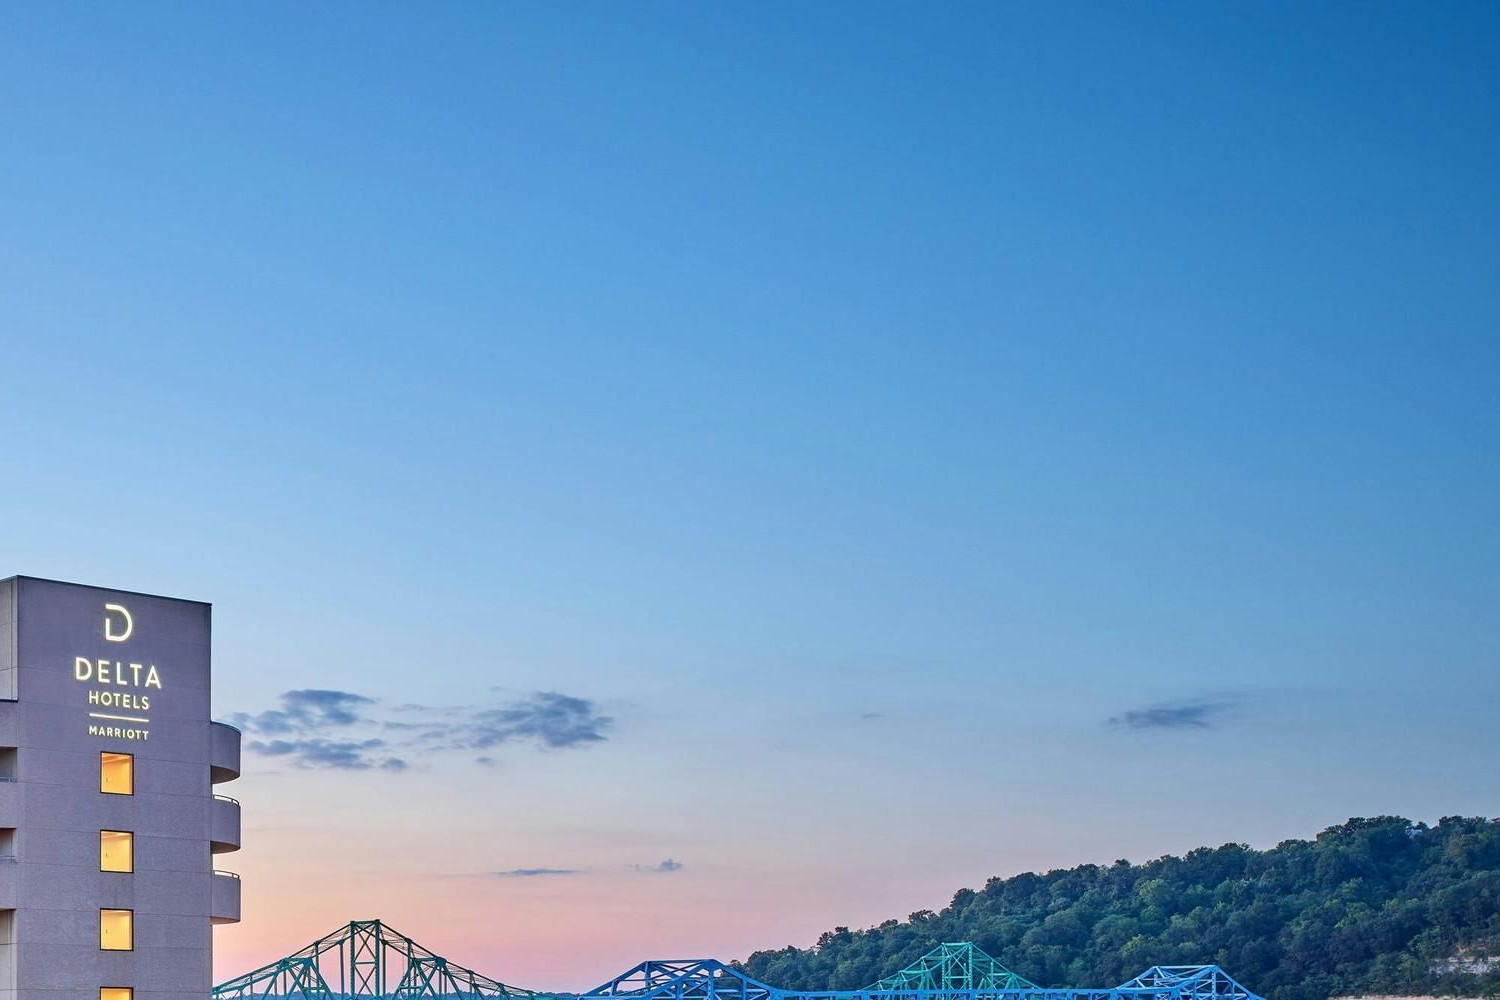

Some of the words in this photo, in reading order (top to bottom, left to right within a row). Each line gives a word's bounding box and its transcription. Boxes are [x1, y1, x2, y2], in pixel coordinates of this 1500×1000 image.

[105, 603, 133, 642] D
[74, 656, 162, 689] DELTA
[88, 690, 149, 710] HOTELS
[88, 725, 149, 741] MARRIOTT
